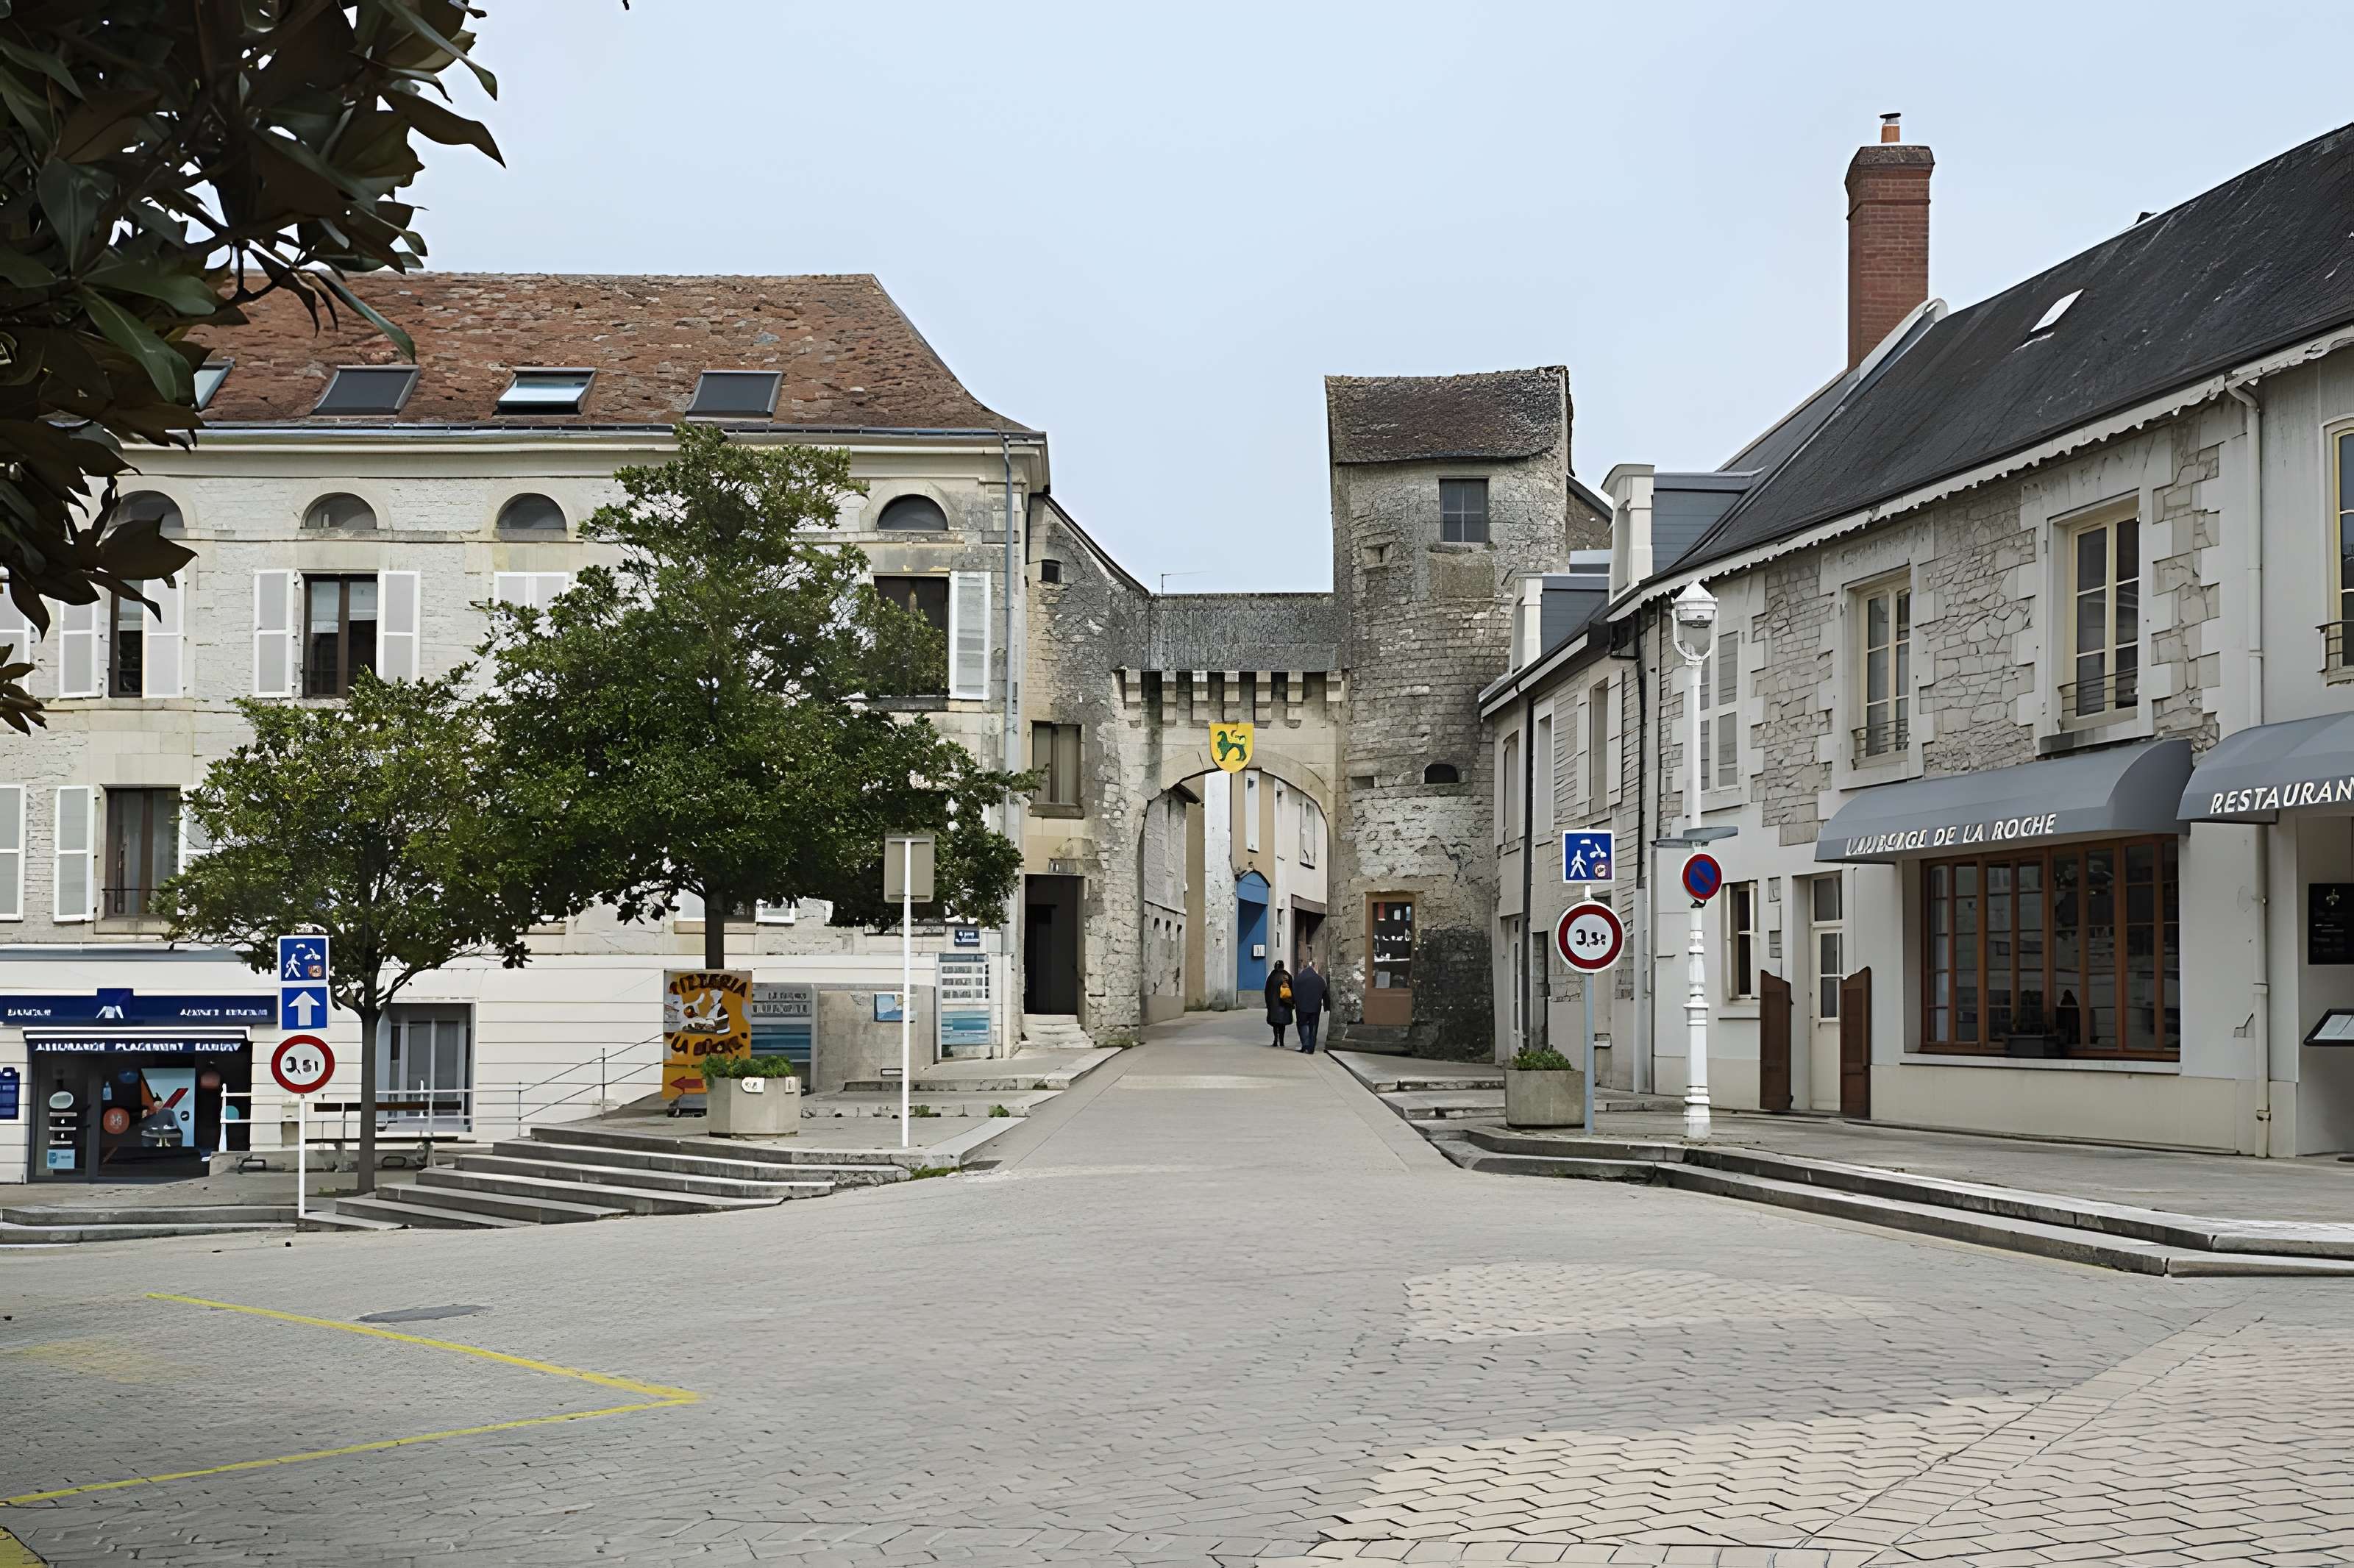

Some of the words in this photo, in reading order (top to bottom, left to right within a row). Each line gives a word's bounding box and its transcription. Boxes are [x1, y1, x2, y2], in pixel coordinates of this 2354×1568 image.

[2210, 777, 2354, 814] RESTAURAN
[1933, 827, 1957, 846] DE
[1963, 824, 1984, 844] LA
[1991, 813, 2057, 841] ROCHE
